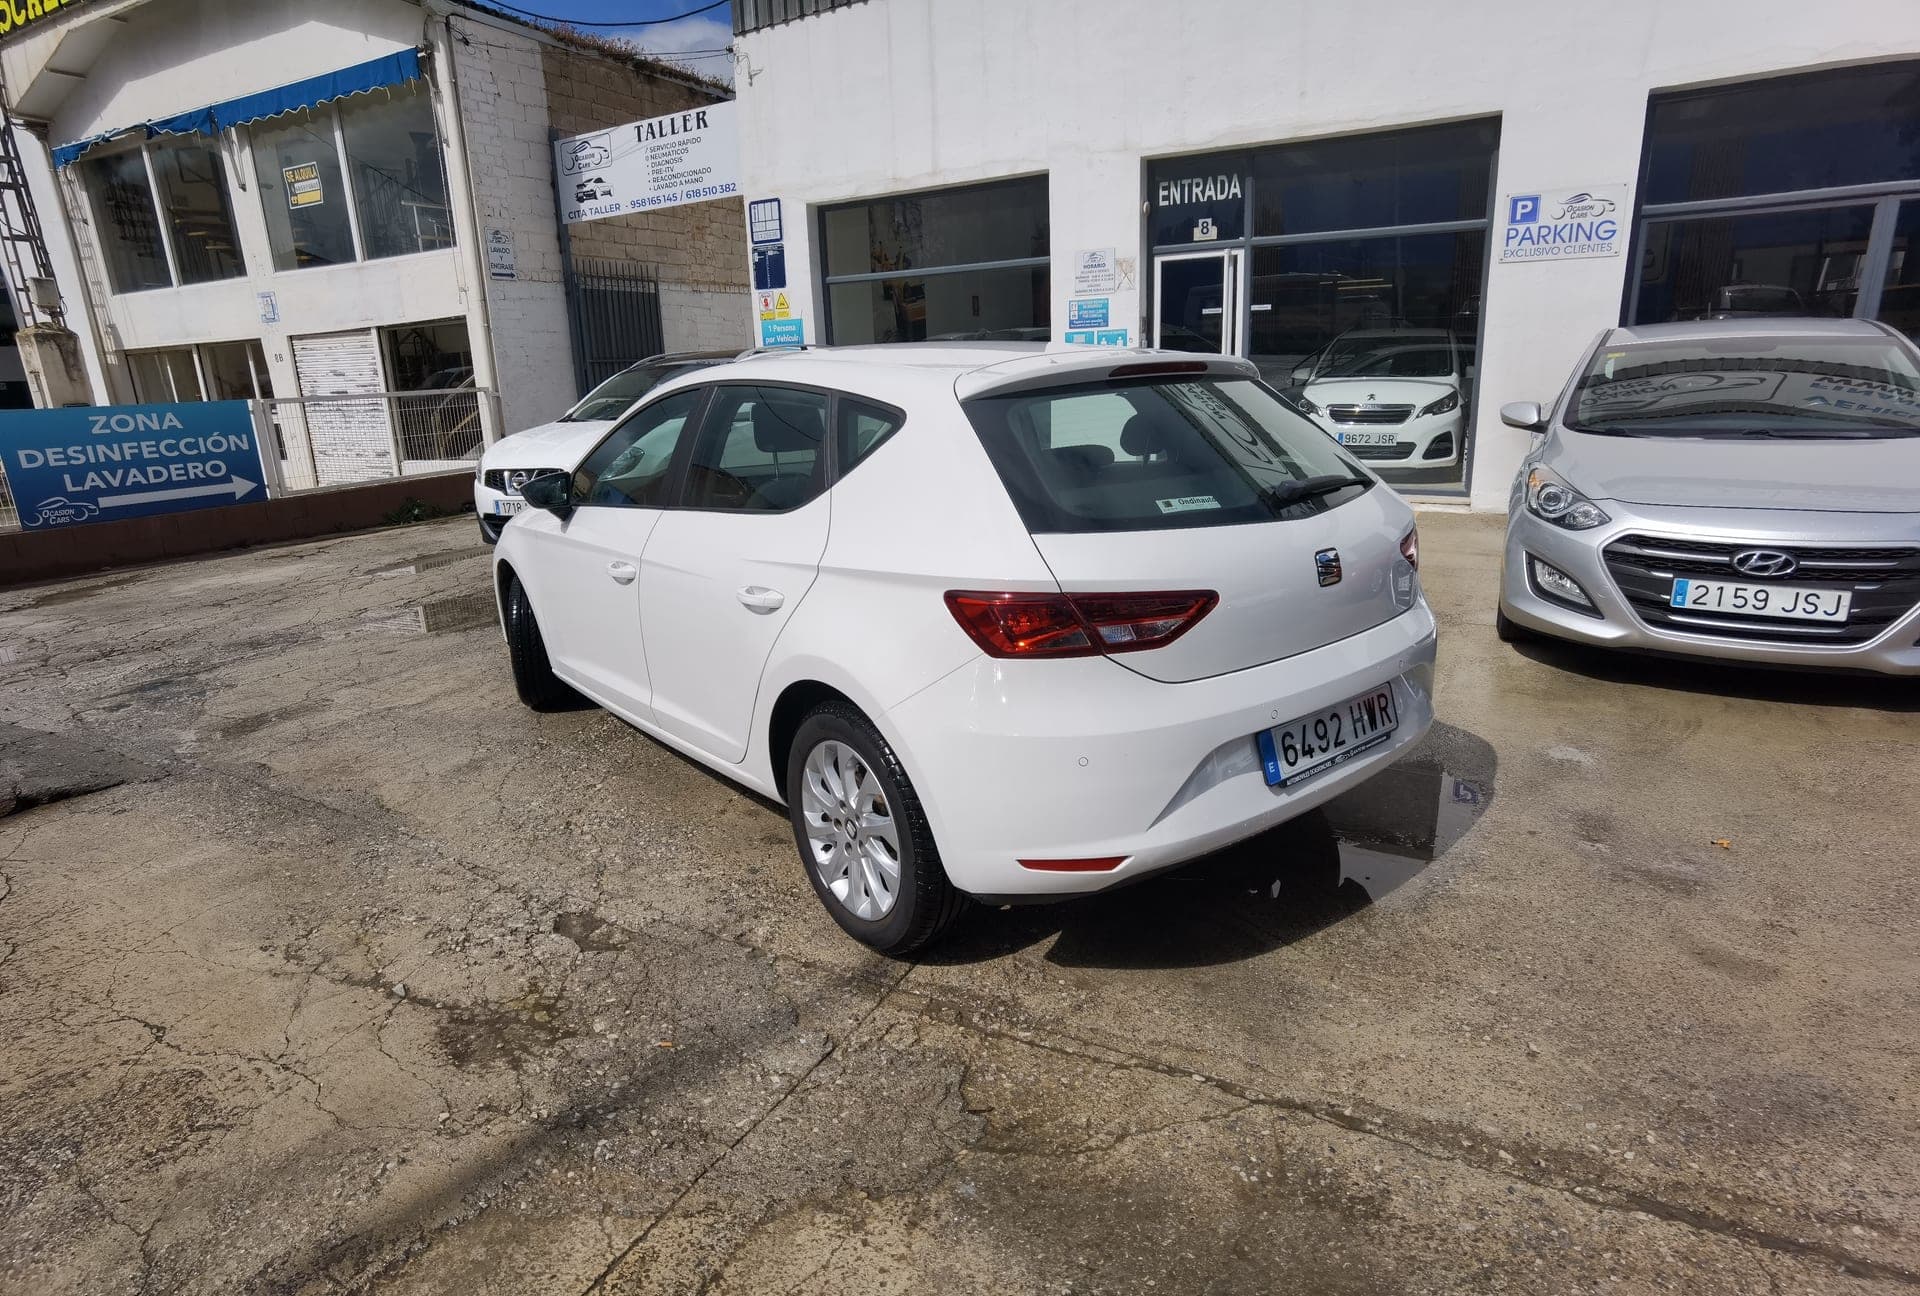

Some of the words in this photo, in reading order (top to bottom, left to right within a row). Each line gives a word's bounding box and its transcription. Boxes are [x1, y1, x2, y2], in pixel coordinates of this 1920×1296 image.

[634, 110, 710, 142] TALLER
[649, 141, 677, 153] SERVICIO
[651, 156, 683, 168] DIAGNOSIS
[651, 165, 675, 176] PRE-ITV
[652, 166, 712, 183] REACONDICIONADO
[653, 181, 678, 192] LAVADO
[685, 176, 704, 185] MANO
[1158, 173, 1242, 207] ENTRADA
[568, 208, 588, 220] CITA
[589, 203, 621, 216] TALLER
[1515, 200, 1533, 221] P
[1566, 204, 1596, 213] OCASION
[1570, 212, 1588, 220] CARS
[1200, 221, 1210, 235] 8
[1505, 220, 1617, 247] PARKING
[1503, 246, 1561, 259] EXCLUSIVO
[1564, 242, 1613, 254] CLIENTES
[88, 411, 184, 435] ZONA
[1345, 433, 1371, 444] 9672
[1374, 434, 1395, 445] JSR
[17, 431, 251, 469] DESINFECCIÓN
[63, 460, 228, 493] LAVADERO
[42, 508, 75, 518] OCASION
[49, 515, 70, 525] CARS
[1692, 584, 1770, 611] 2159
[1781, 591, 1843, 617] JSJ
[1281, 712, 1346, 767] 6492
[1350, 692, 1393, 739] HWR
